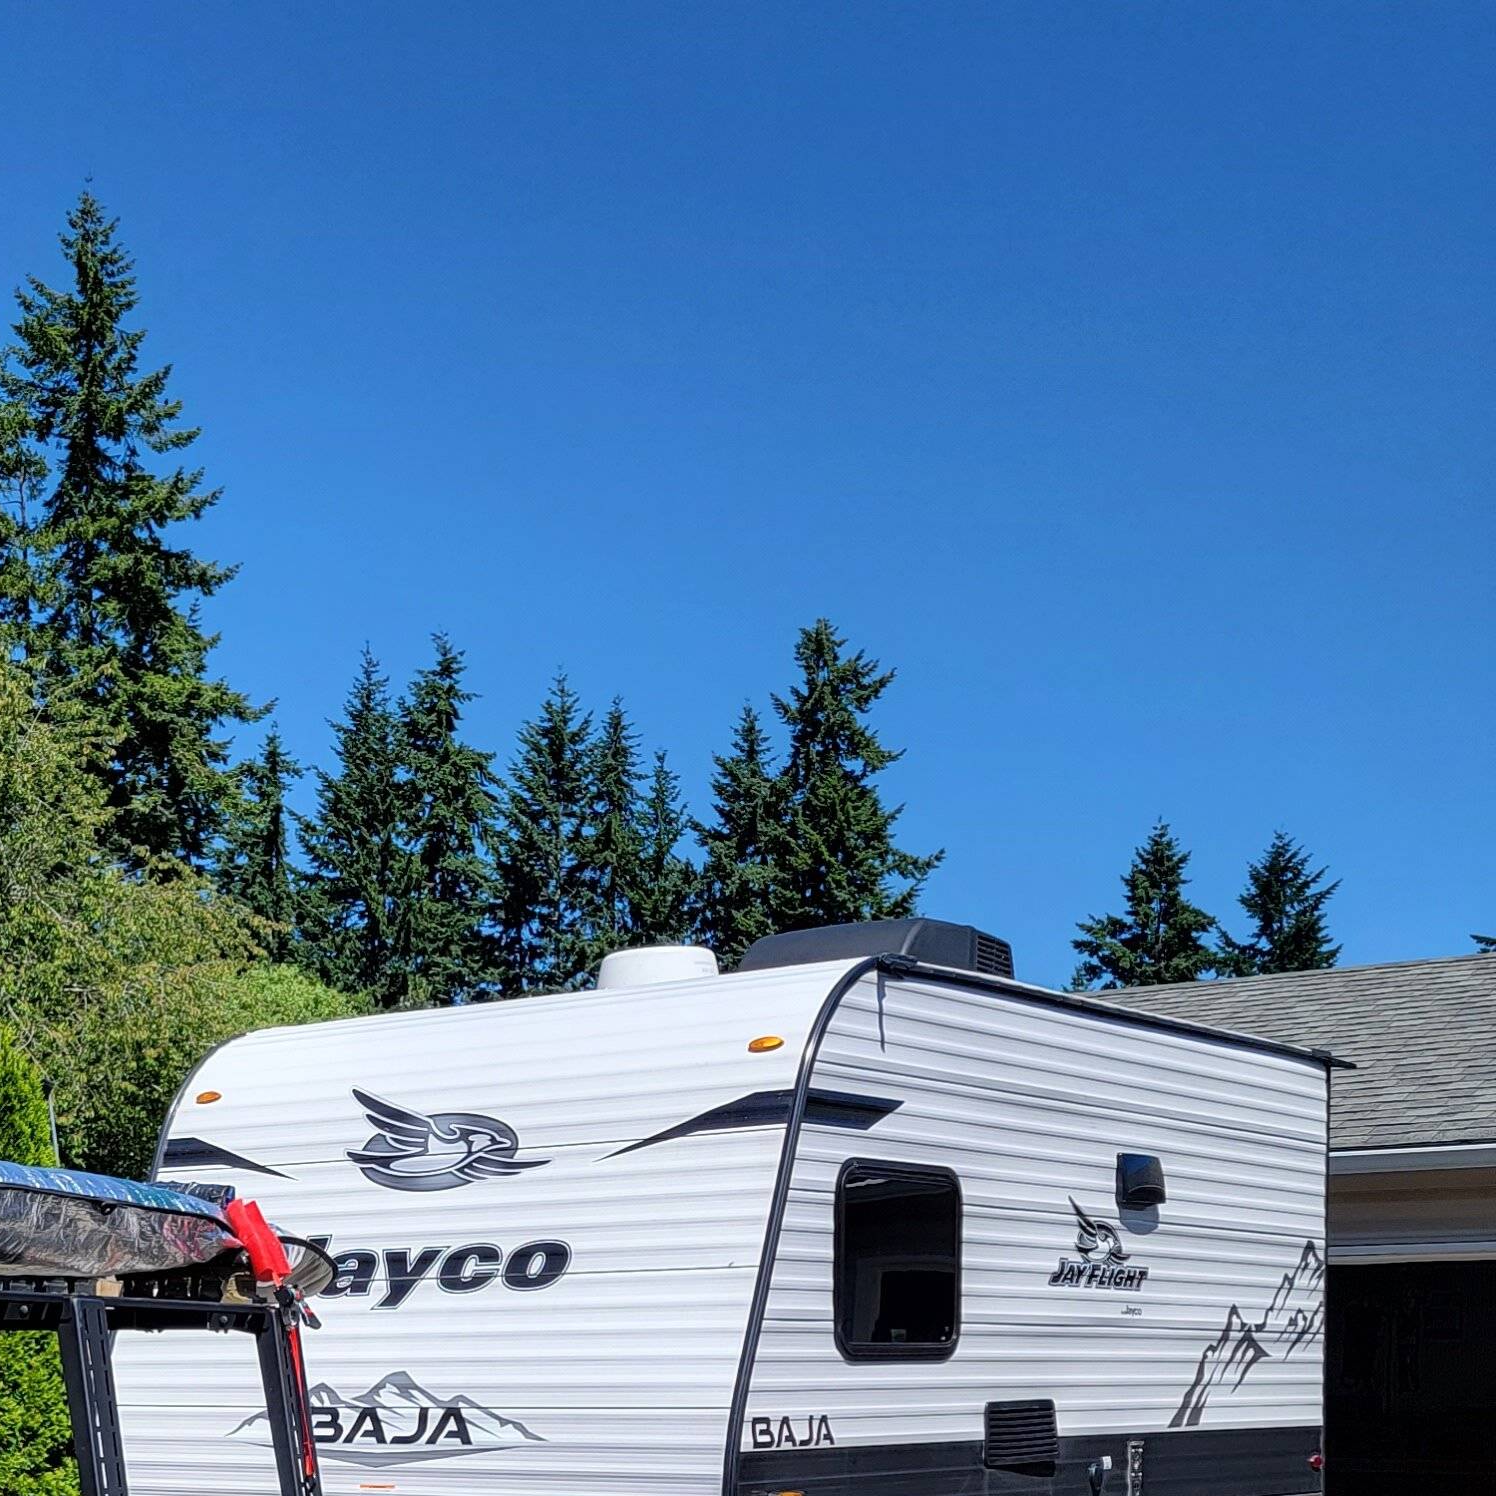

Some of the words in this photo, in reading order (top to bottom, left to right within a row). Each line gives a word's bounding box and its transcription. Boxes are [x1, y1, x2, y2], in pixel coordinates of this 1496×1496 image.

[306, 1234, 572, 1310] ayco
[1048, 1257, 1087, 1287] JAY
[1084, 1263, 1149, 1291] FLIGHT
[310, 1406, 473, 1445] BAJA
[751, 1414, 835, 1449] BAJA
